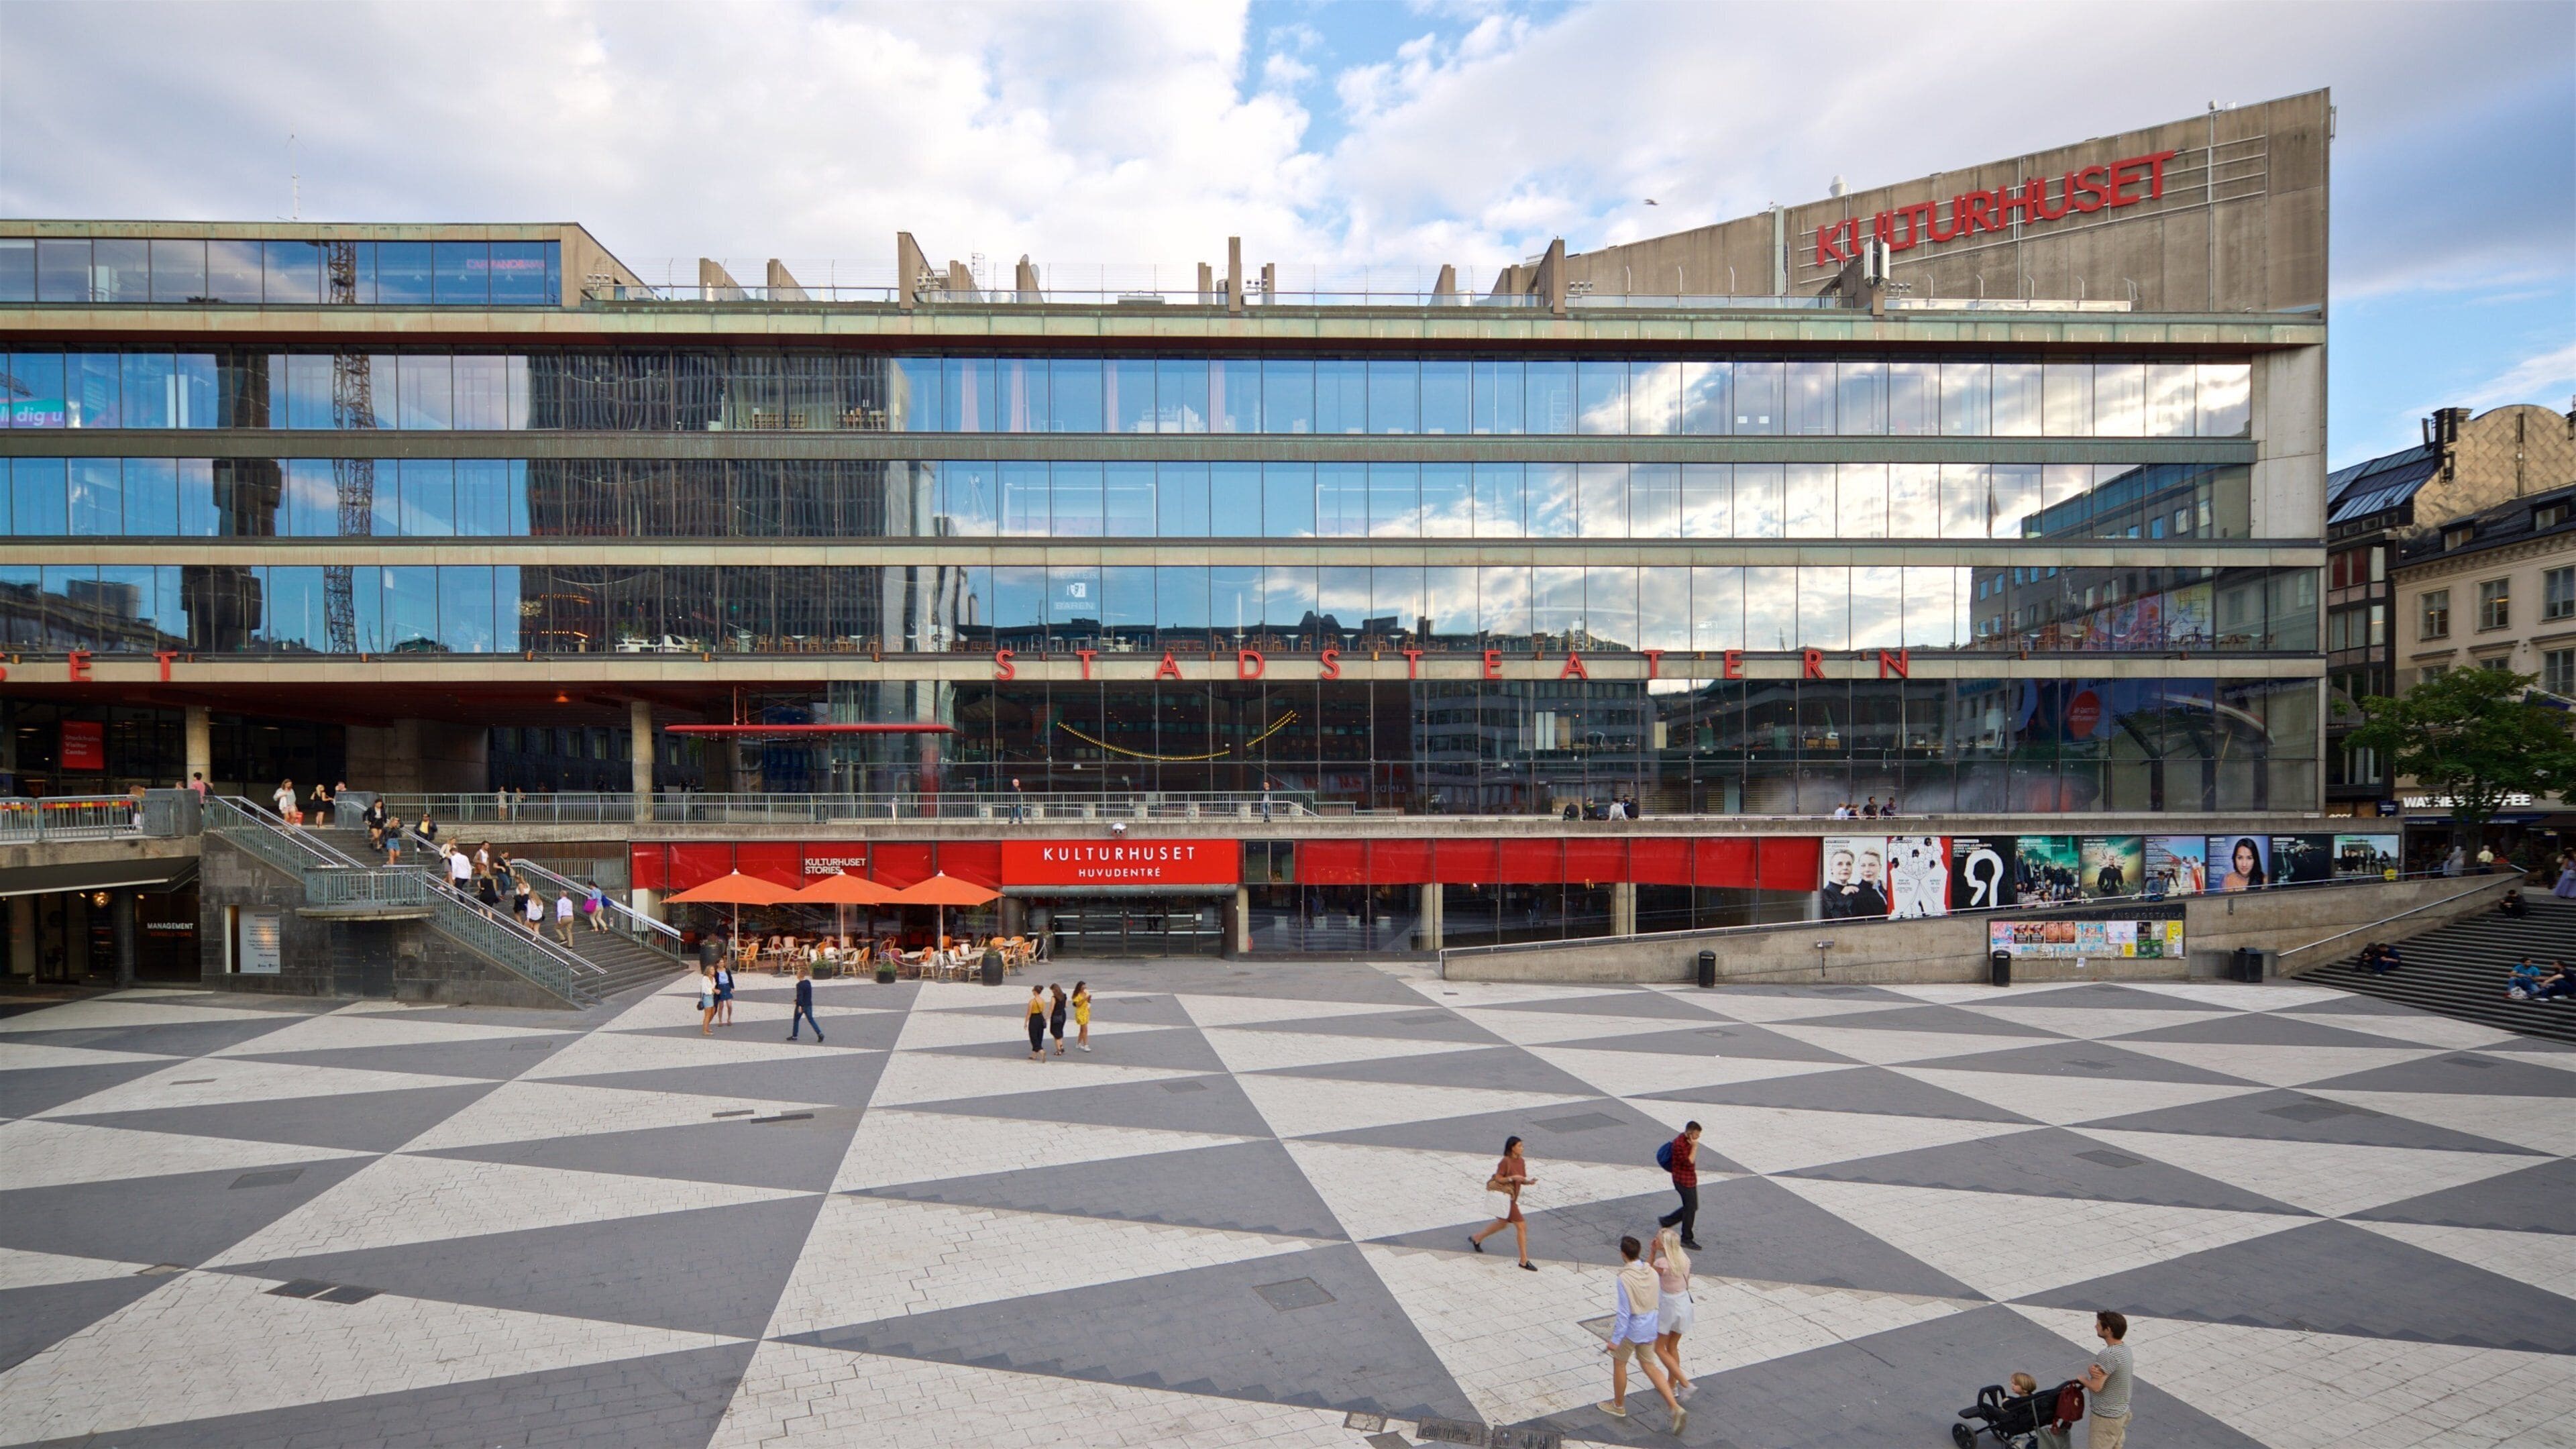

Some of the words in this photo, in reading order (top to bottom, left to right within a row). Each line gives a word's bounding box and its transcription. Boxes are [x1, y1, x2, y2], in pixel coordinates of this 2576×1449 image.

[1817, 150, 2176, 267] KULTURHUSET
[17, 406, 45, 426] dig
[995, 649, 1909, 680] STADSTEATERN
[1044, 847, 1195, 861] KULTURHUSET
[805, 858, 866, 866] KULTURHUSET
[805, 866, 841, 874] STORIES
[1079, 866, 1161, 877] HUVUDENTRÉ
[2111, 911, 2184, 920] ANSLAGSTAVLA
[147, 922, 193, 930] MANAGEMENT
